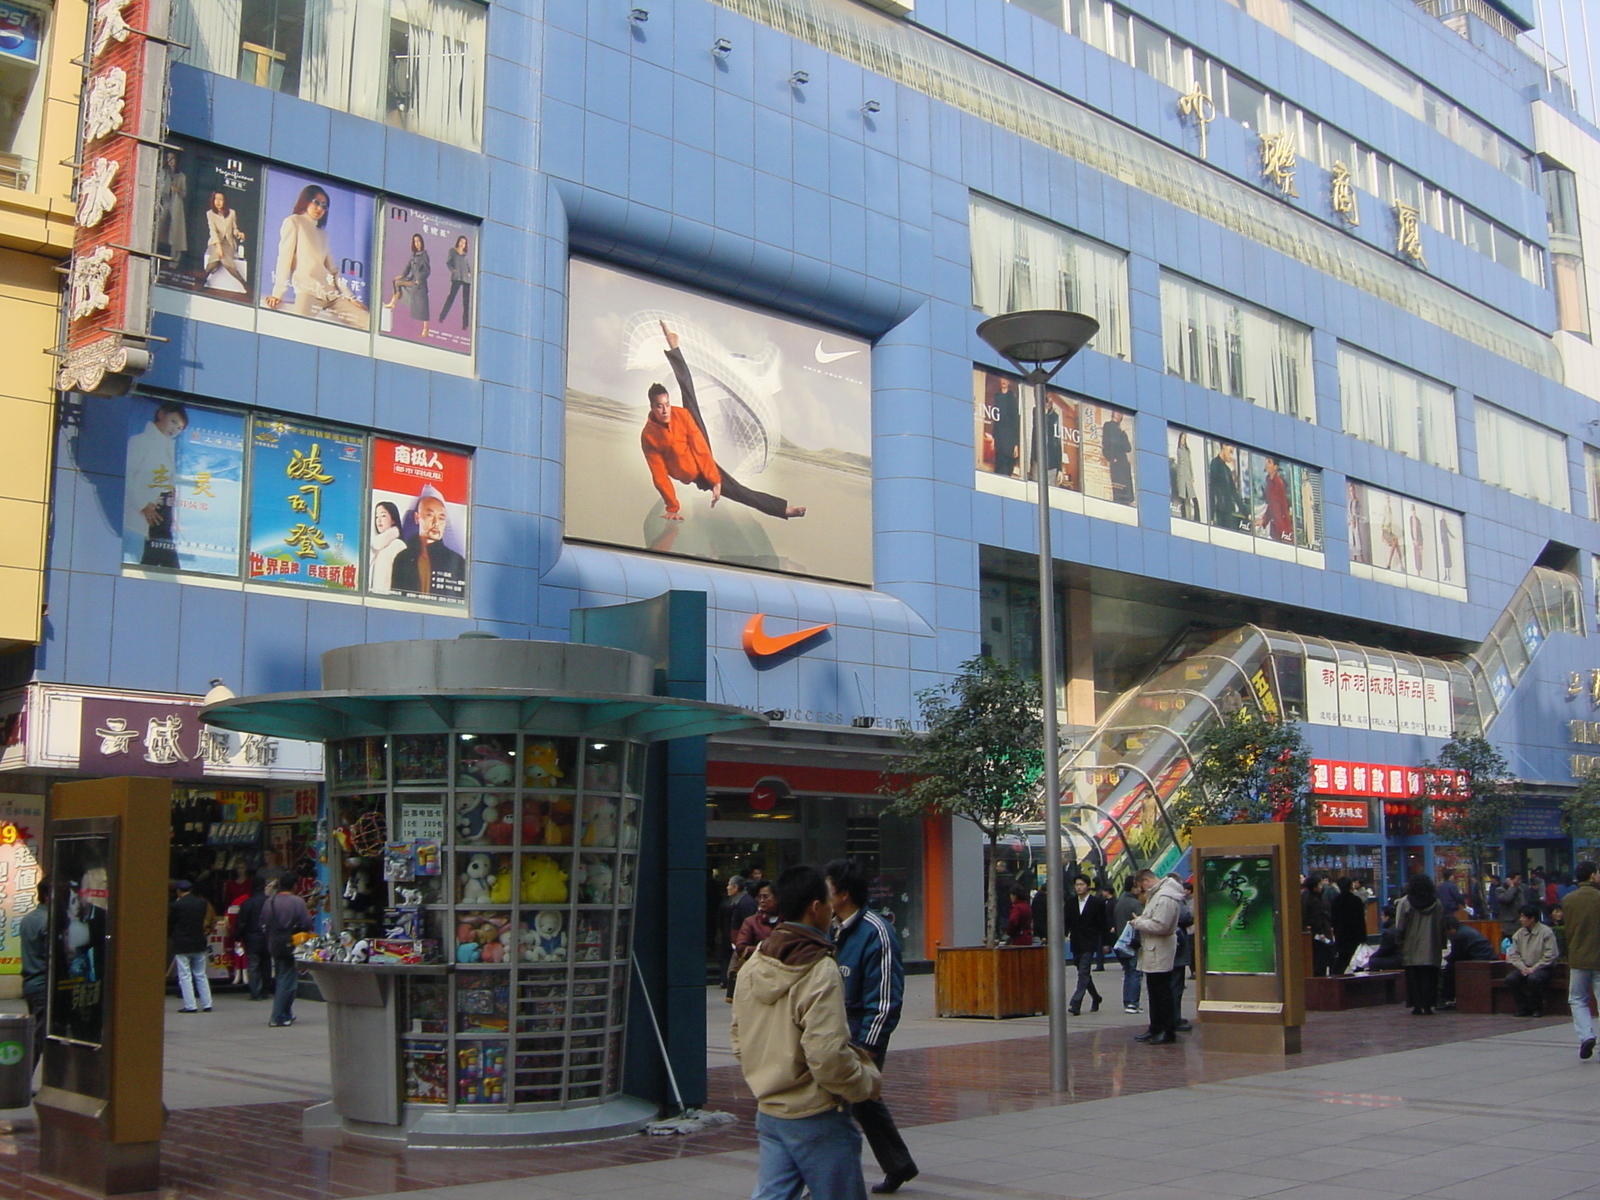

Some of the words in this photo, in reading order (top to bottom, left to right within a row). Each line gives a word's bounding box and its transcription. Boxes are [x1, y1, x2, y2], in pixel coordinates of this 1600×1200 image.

[1053, 423, 1081, 444] LING
[395, 445, 443, 470] 南极人
[284, 443, 336, 559] 波司登
[249, 552, 300, 579] 世界品牌
[307, 564, 357, 590] 民族骄傲
[1322, 668, 1438, 703] 都市羽绒服新品展
[773, 707, 843, 724] SUCCESS
